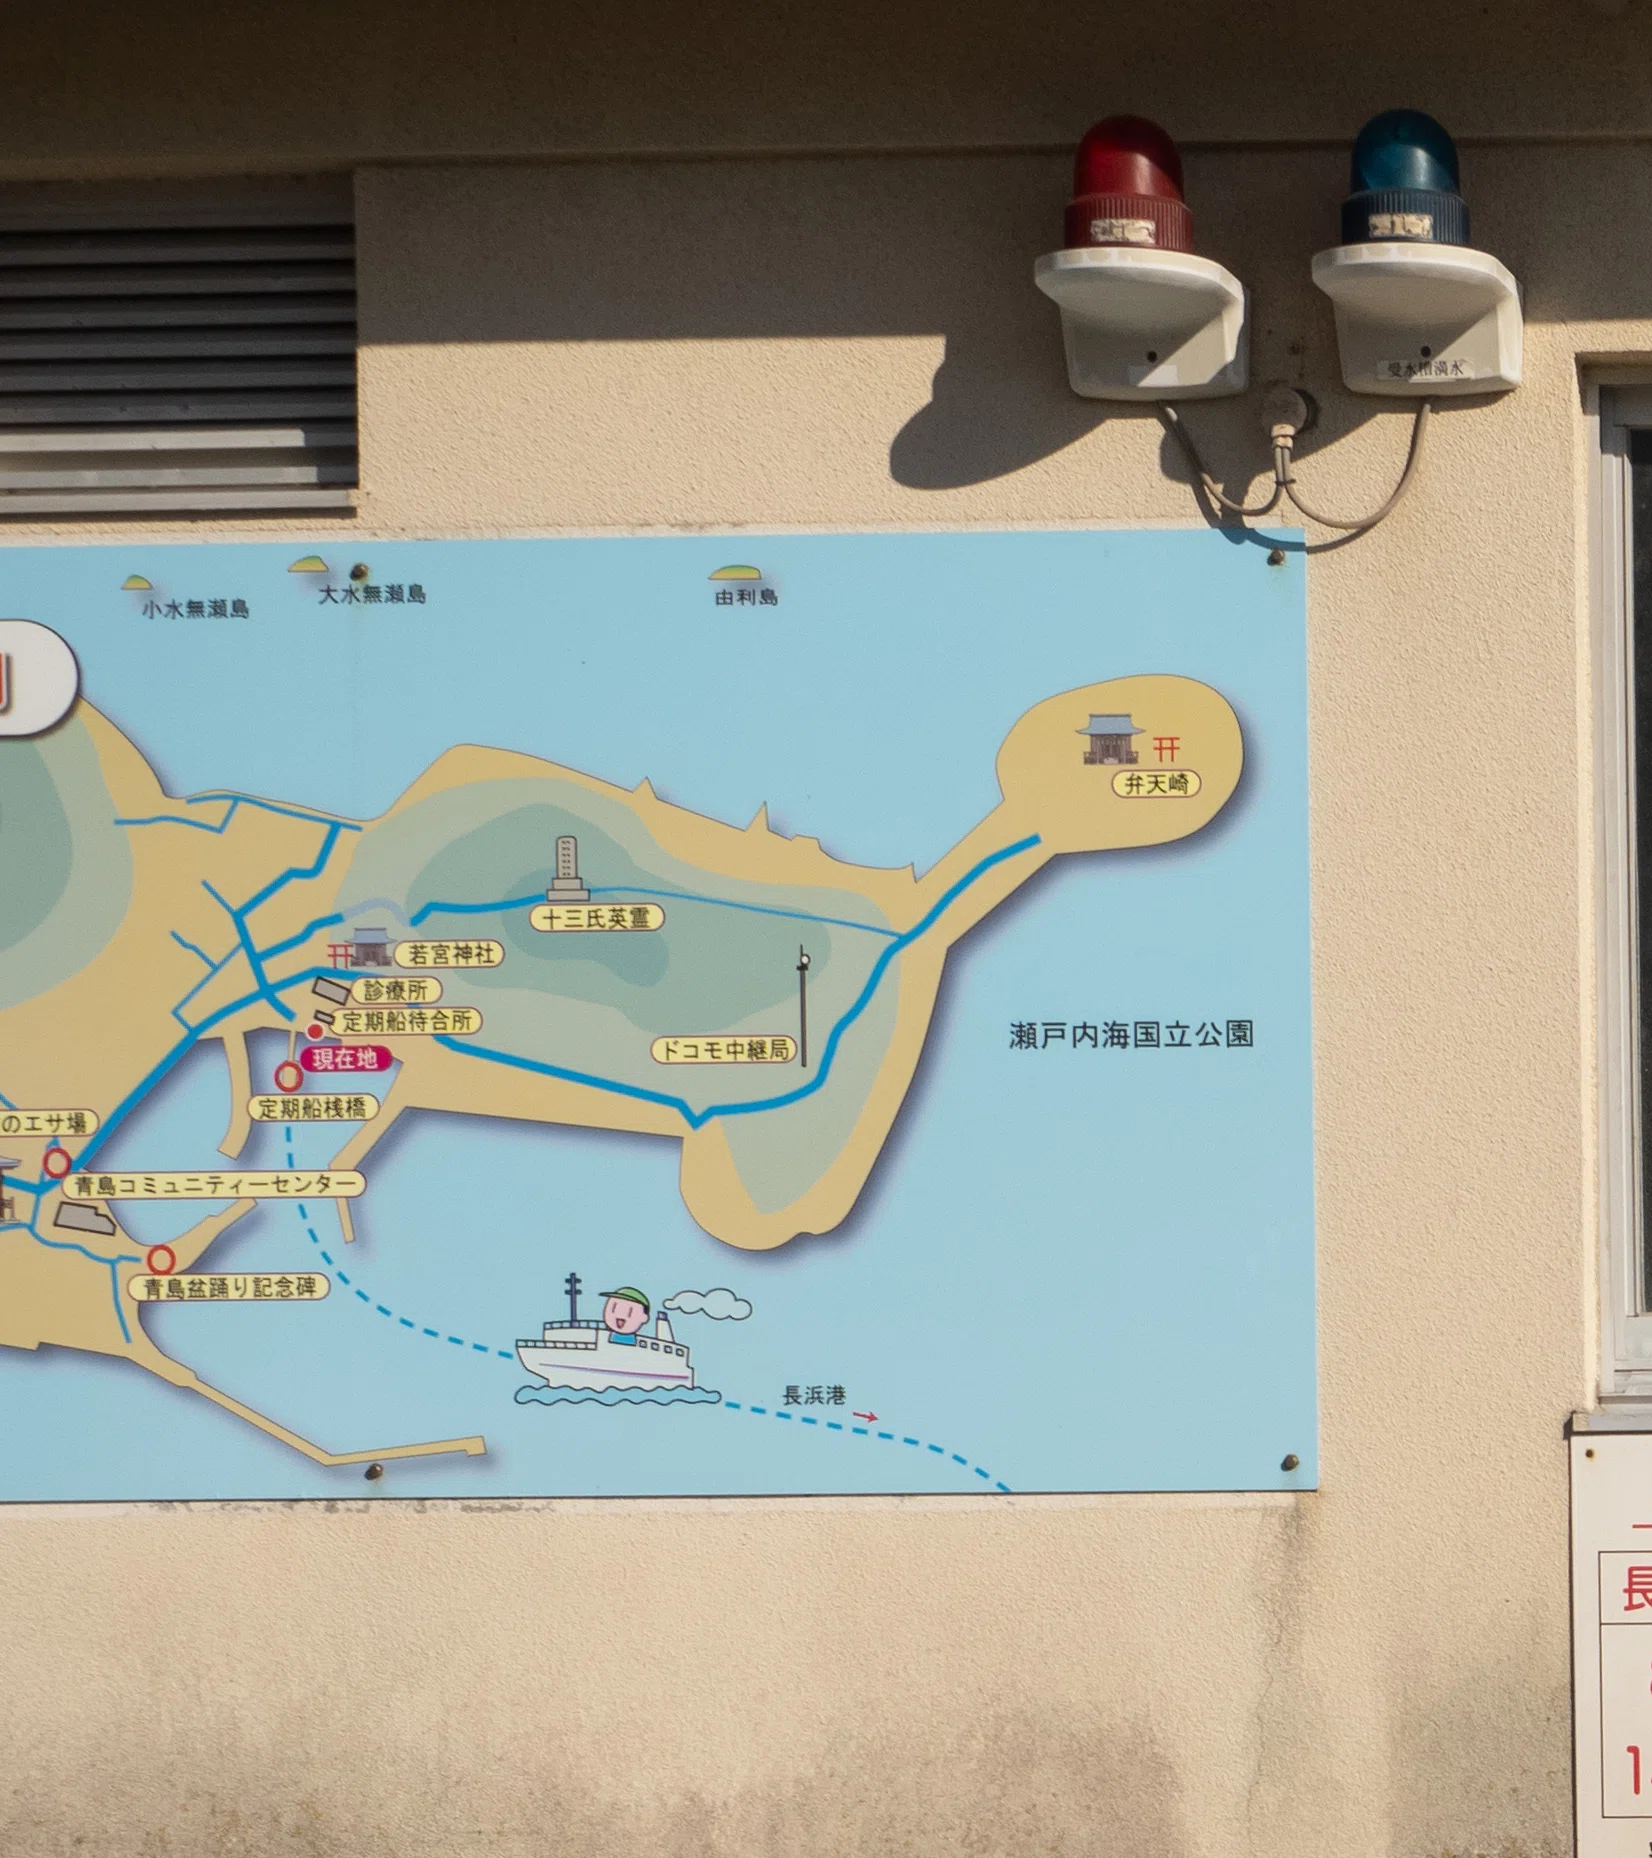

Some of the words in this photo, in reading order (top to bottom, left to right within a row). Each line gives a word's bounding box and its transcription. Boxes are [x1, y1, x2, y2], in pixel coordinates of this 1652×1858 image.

[319, 584, 425, 604] 大水無瀬島
[716, 588, 777, 606] 由利島
[143, 599, 248, 619] 小水無瀬島
[1125, 773, 1189, 795] 弁天崎
[543, 907, 650, 930] 十三氏英霊
[410, 943, 495, 965] 若宮神社
[364, 980, 428, 1001] 診療所
[344, 1009, 472, 1032] 定期船待合所
[1010, 1020, 1253, 1049] 瀬戸内海国立公園
[311, 1047, 380, 1071] 現在地
[659, 1037, 792, 1063] ドコモ中継局
[257, 1097, 368, 1121] 定期船桟橋
[2, 1112, 87, 1134] のエサ場
[75, 1174, 358, 1197] 青島コミュニティーセンター
[143, 1275, 317, 1300] 青島盆踊り記念碑
[783, 1385, 845, 1405] 長浜港
